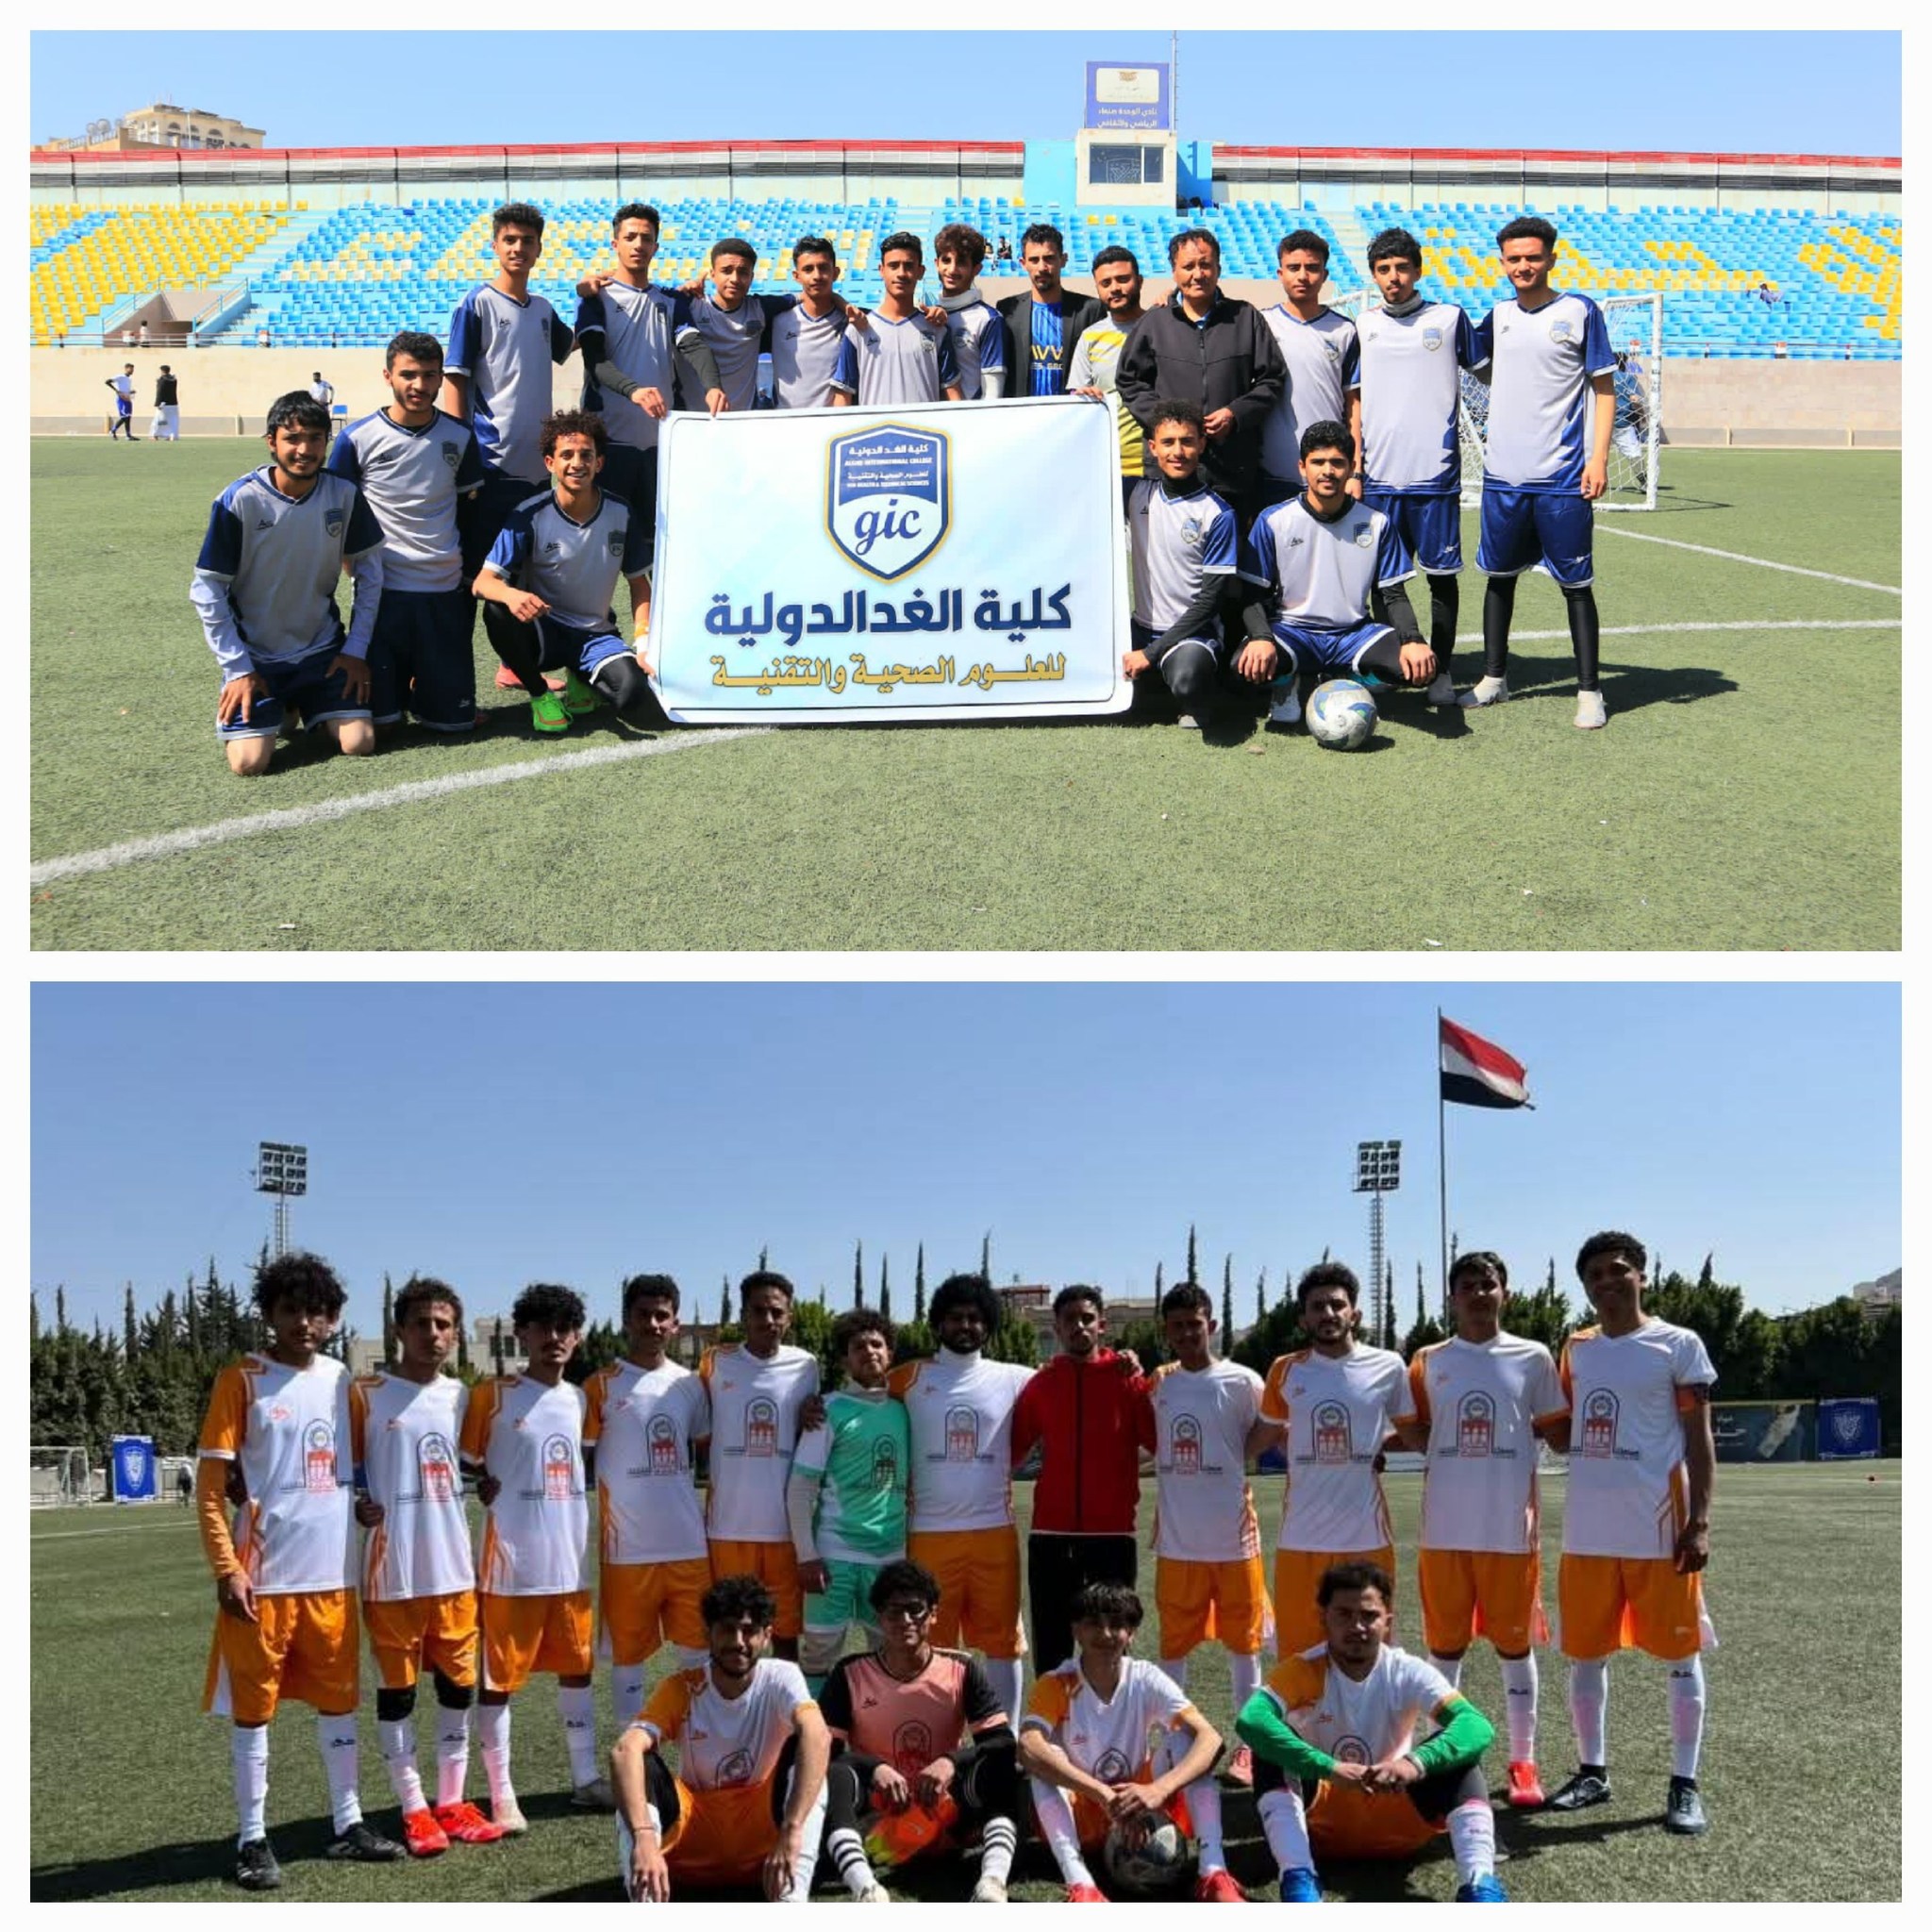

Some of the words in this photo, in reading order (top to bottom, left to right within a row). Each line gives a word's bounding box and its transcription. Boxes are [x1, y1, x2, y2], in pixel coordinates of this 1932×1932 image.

[908, 443, 929, 455] كلية
[855, 499, 922, 555] gic
[974, 583, 1072, 642] كلية
[710, 655, 847, 696] والتقنية
[851, 653, 956, 694] الصحية
[958, 651, 1067, 691] للعلوم
